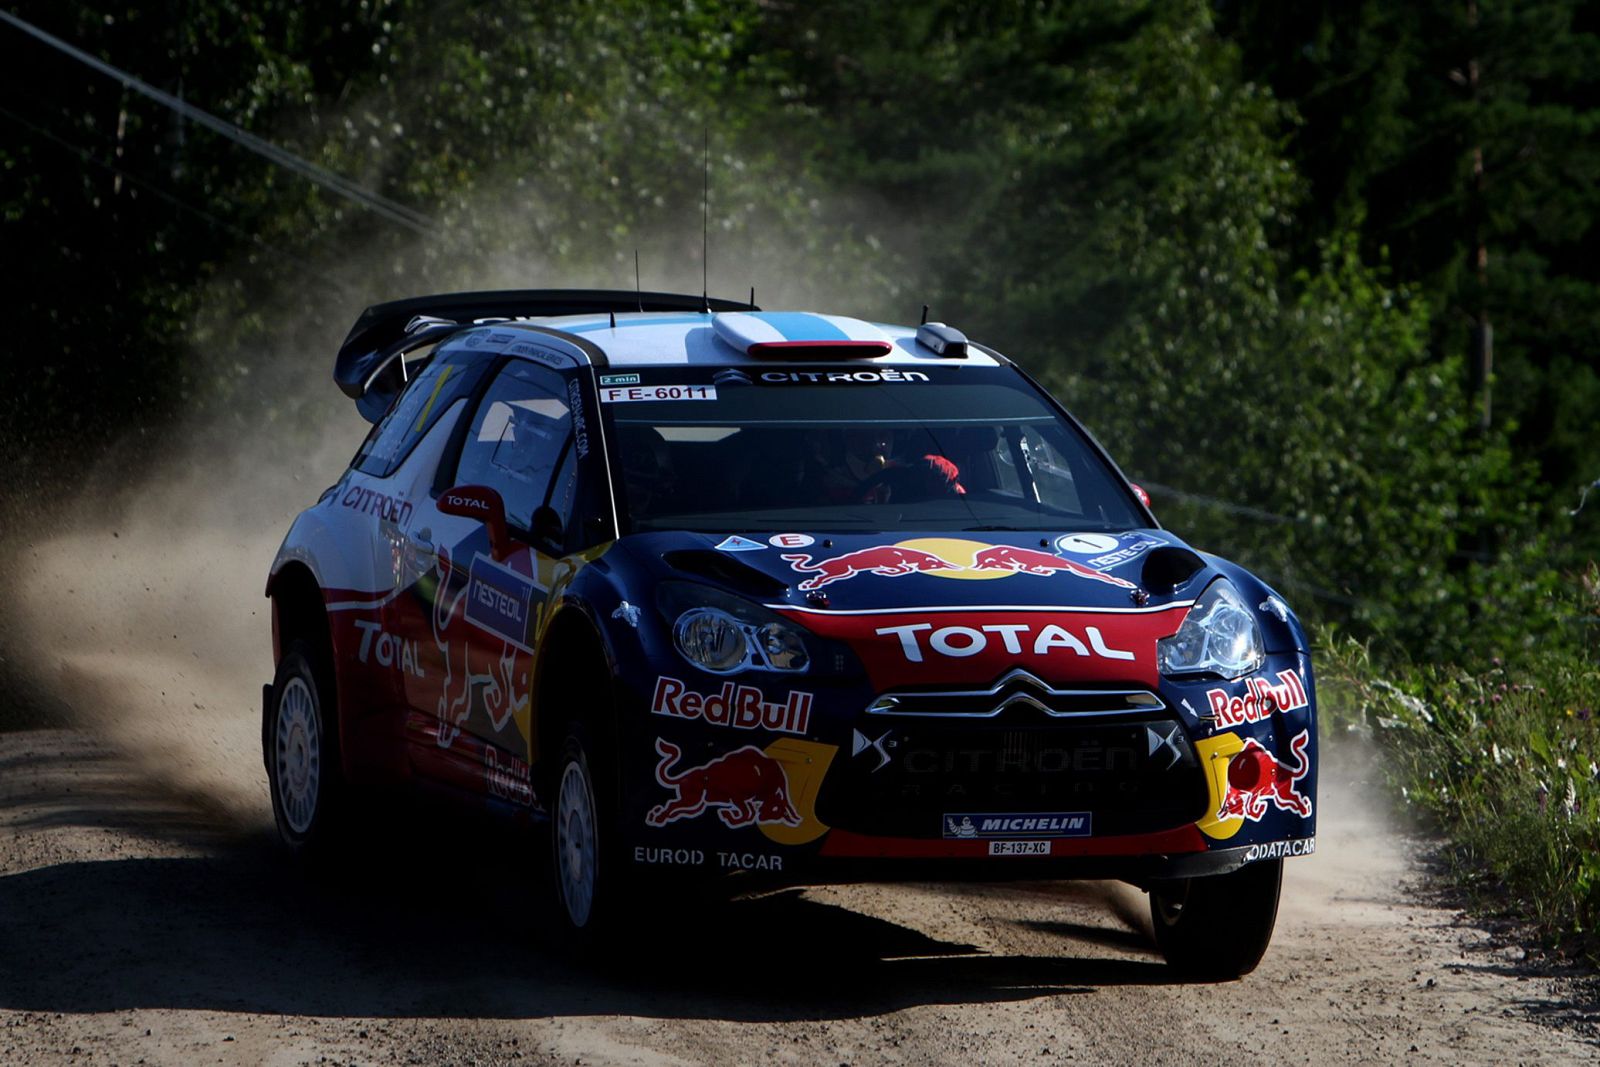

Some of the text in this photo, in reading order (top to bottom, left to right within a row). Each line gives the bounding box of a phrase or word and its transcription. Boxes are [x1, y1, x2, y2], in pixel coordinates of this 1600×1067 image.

[446, 494, 490, 511] TOTAL
[780, 535, 803, 546] E
[354, 619, 425, 678] TOTAL
[875, 622, 1136, 664] TOTAL
[981, 817, 1084, 831] MICHELIN
[993, 842, 1046, 855] BF-137-XC
